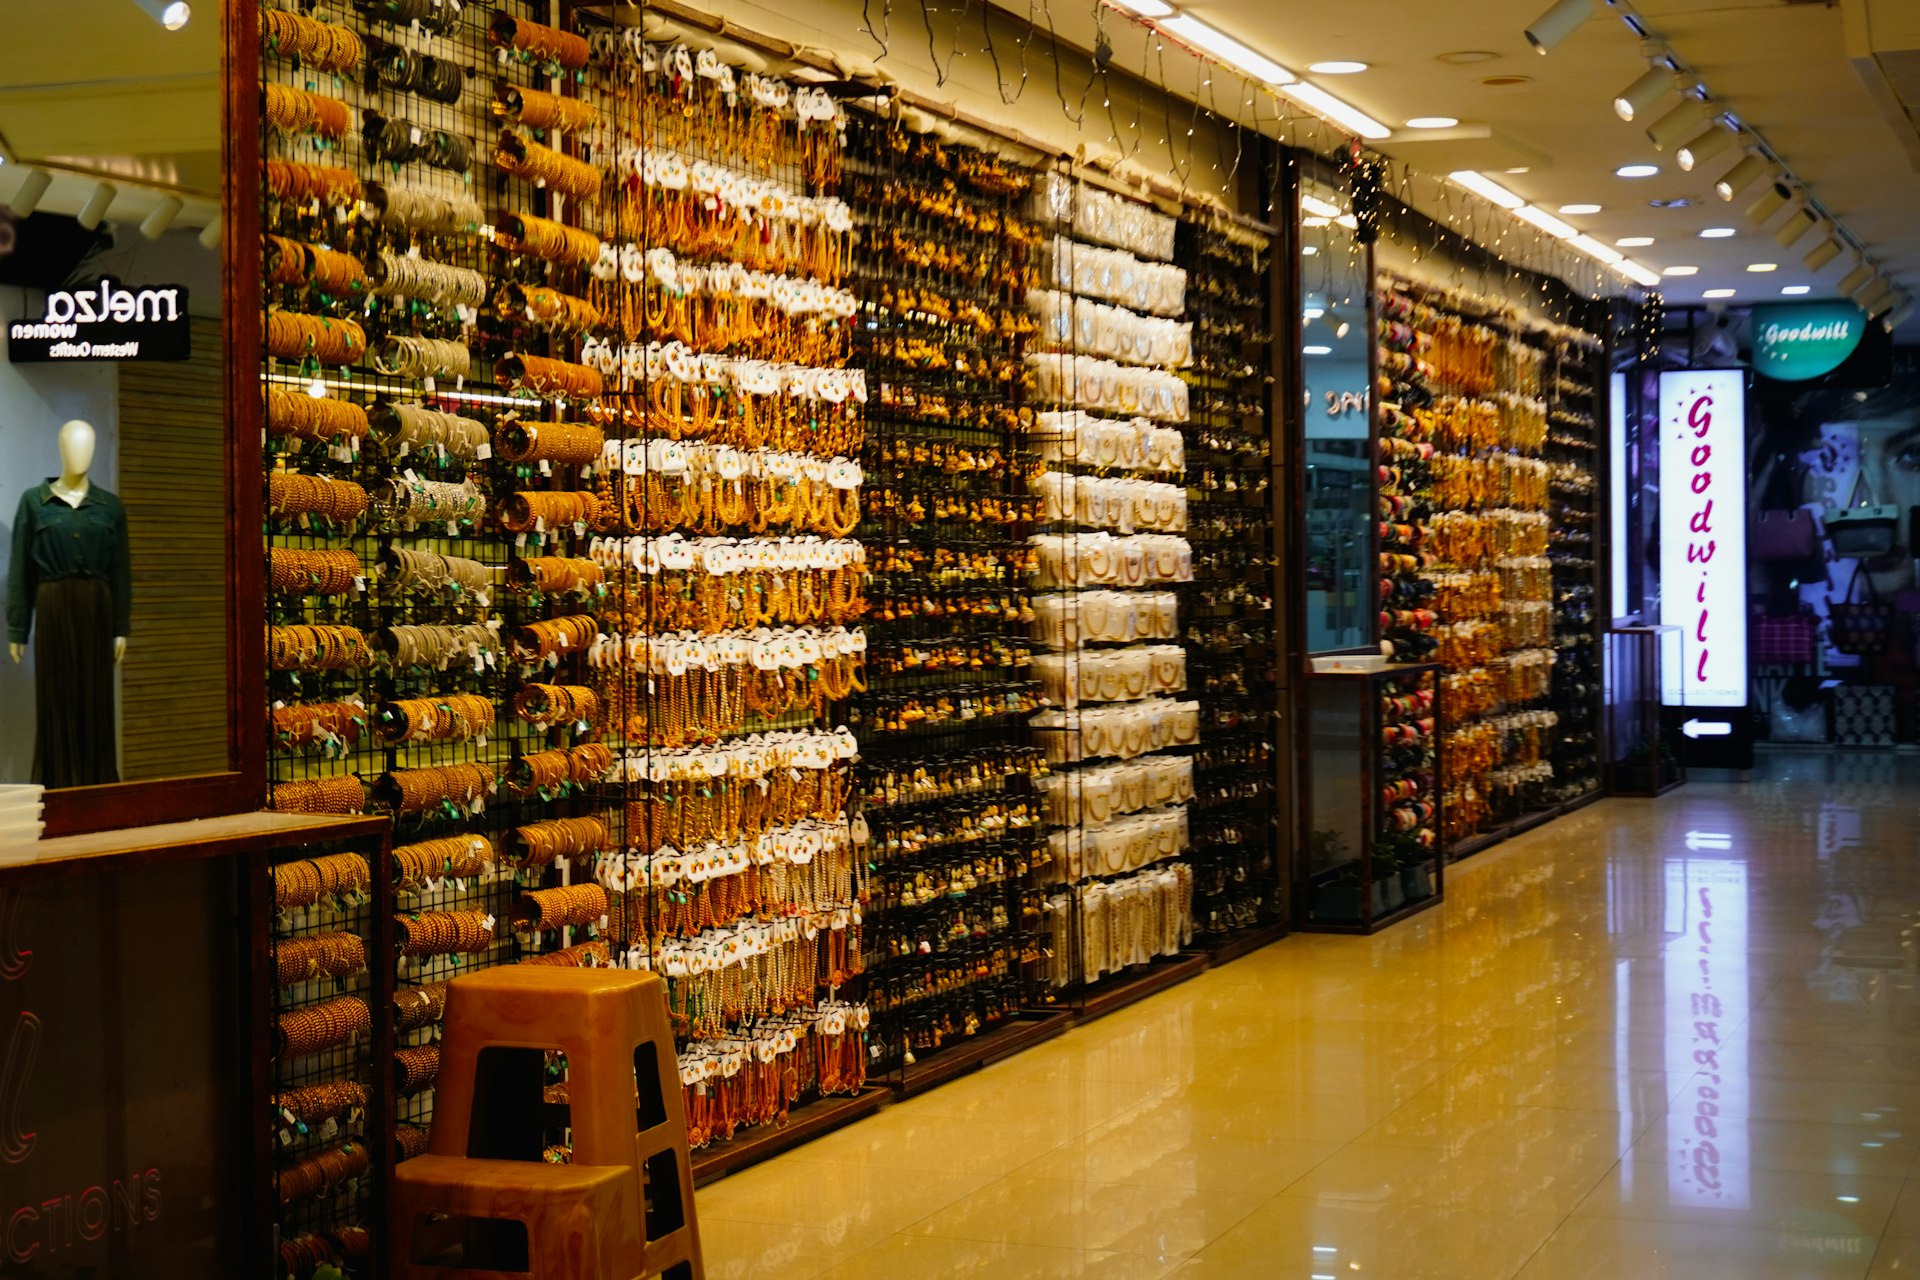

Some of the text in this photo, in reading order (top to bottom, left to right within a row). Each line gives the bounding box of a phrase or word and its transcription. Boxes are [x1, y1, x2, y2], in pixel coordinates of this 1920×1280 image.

[1765, 321, 1849, 345] Goodwill
[1688, 396, 1715, 682] Goodwill
[0, 1168, 162, 1263] CTIONS
